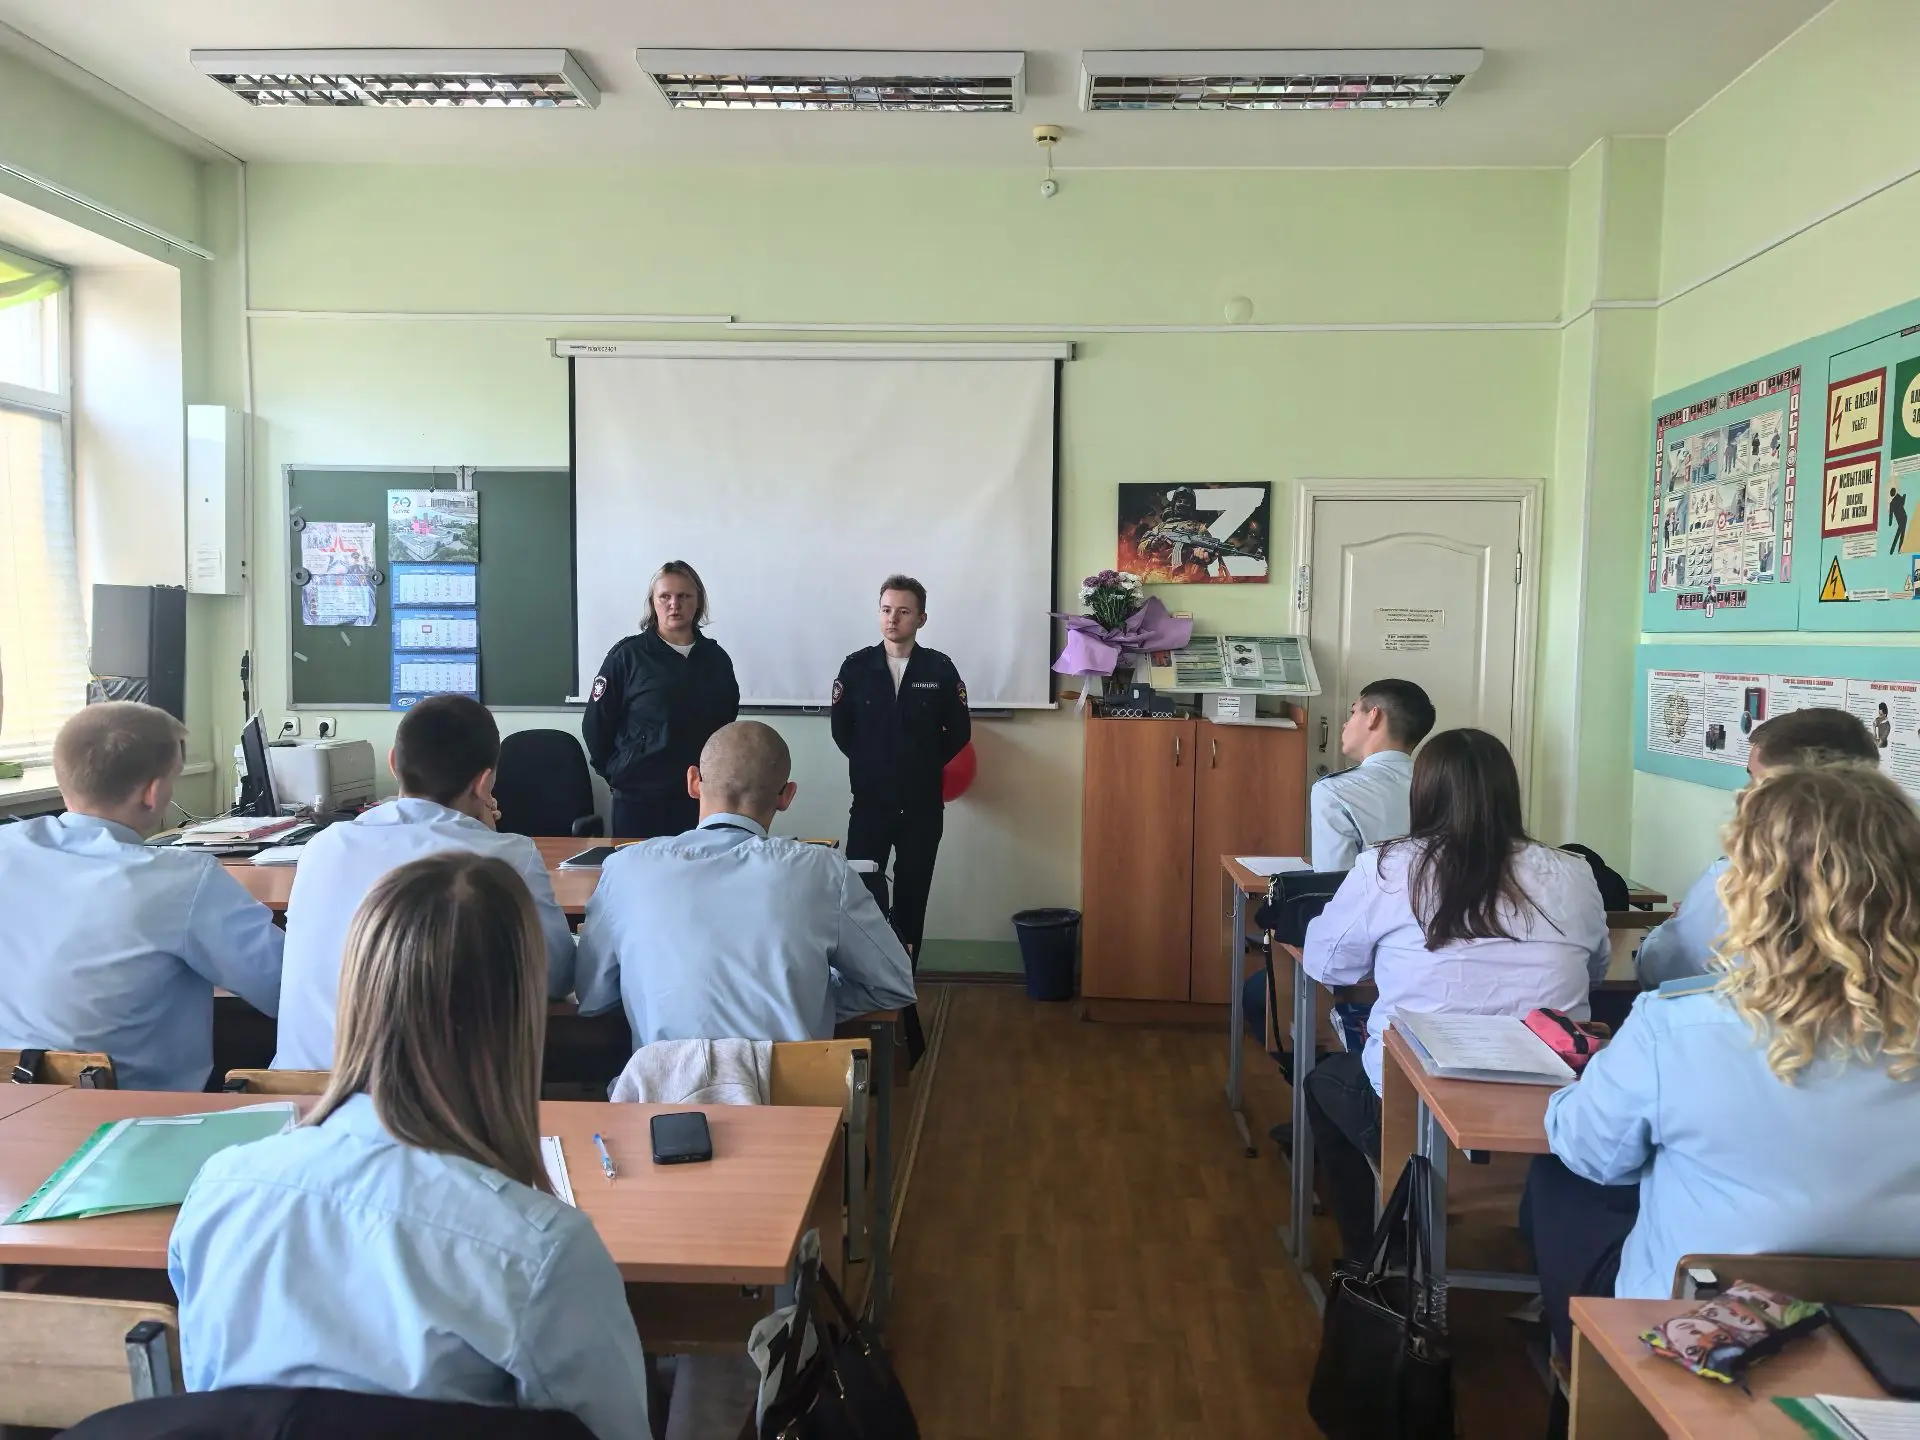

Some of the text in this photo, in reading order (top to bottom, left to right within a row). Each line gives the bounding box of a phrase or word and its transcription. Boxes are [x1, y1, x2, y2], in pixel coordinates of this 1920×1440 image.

[1728, 367, 1800, 408] ТЕРРОРИЗМ
[1845, 387, 1879, 412] НЕ ВЛЕЗАЙ
[1657, 396, 1718, 429] ТЕРРОРИЗМ
[1839, 468, 1873, 488] ИСПЫТАНИЕ
[1846, 493, 1864, 506] ОПАСНО
[1841, 506, 1868, 521] ДЛЯ ЖИЗНИ
[1166, 487, 1268, 577] Z
[1677, 591, 1746, 618] ТЕРРОРИЗМ
